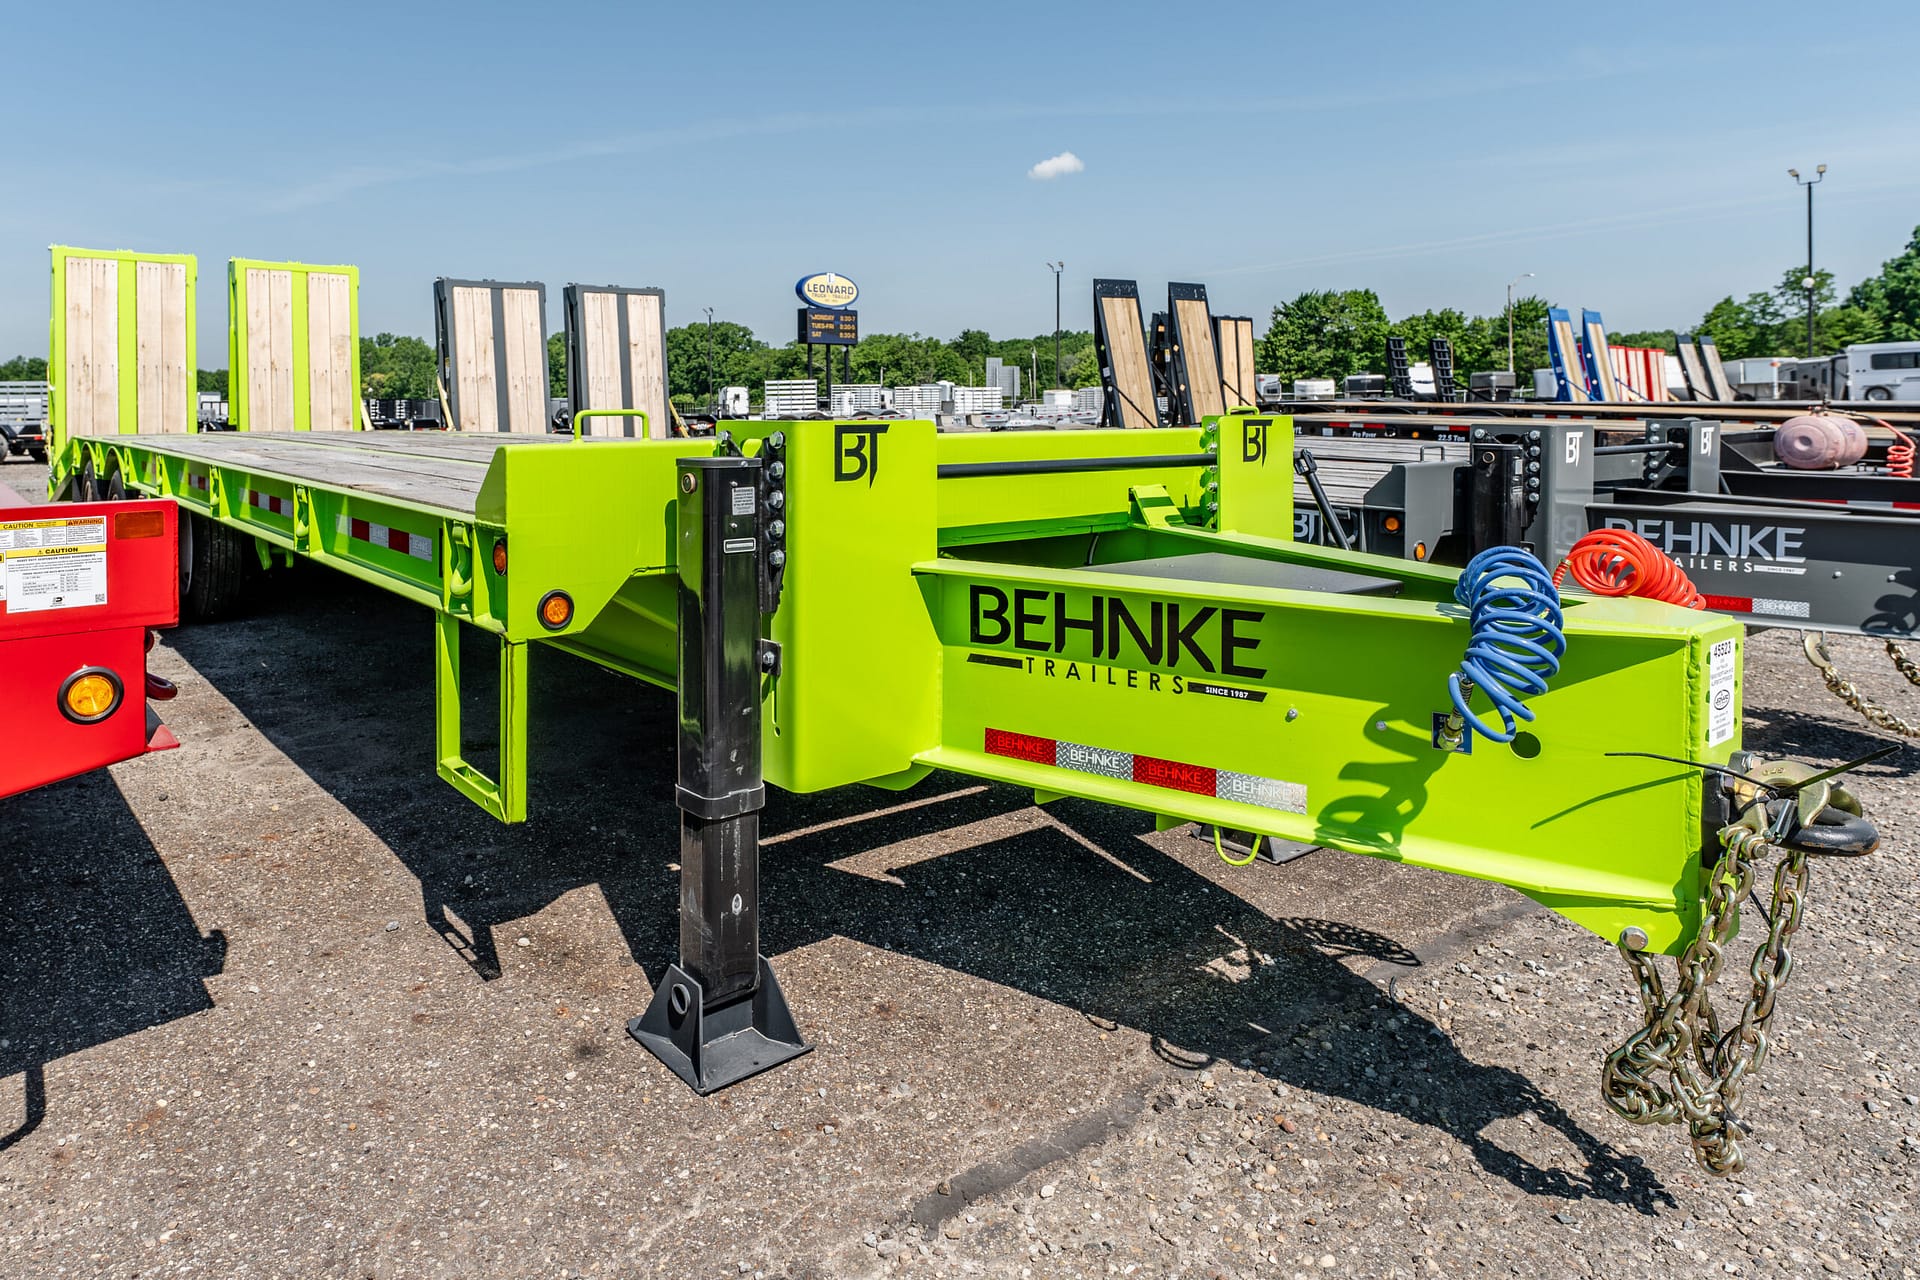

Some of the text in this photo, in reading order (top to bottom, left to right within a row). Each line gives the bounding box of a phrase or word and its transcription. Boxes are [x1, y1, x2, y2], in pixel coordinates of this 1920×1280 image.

[807, 283, 854, 295] LEONARD
[834, 424, 890, 489] BT
[1674, 557, 1753, 573] AILERS
[1762, 602, 1800, 611] BEHNKE
[970, 585, 1268, 680] BEHNKE
[1714, 641, 1732, 657] 45523
[1026, 656, 1184, 695] TRAILERS
[1205, 686, 1249, 698] SINCE 1987
[997, 735, 1043, 753] BEHNKE
[1070, 749, 1120, 769] BEHNKE
[1148, 764, 1202, 784] BEHNKE
[1232, 779, 1294, 801] BEHNKE
